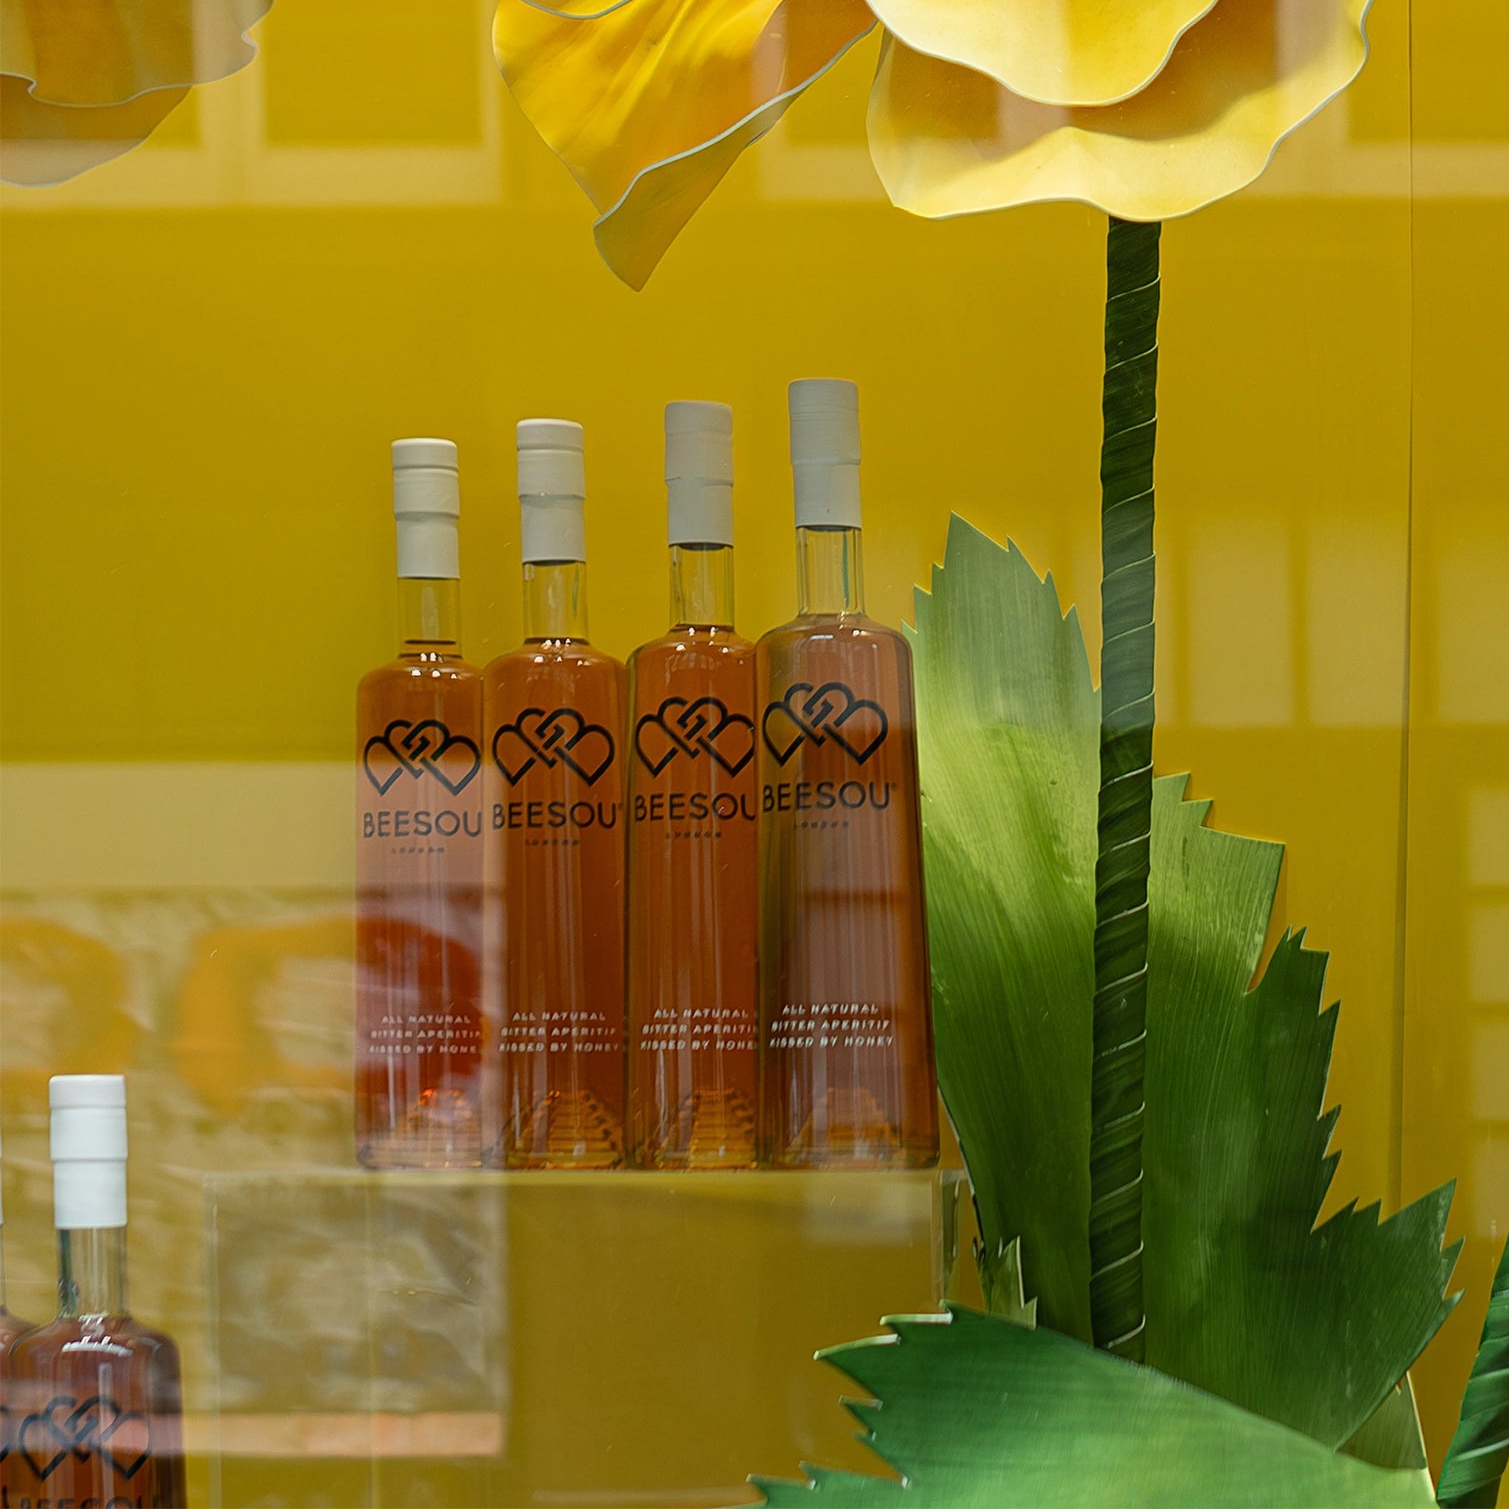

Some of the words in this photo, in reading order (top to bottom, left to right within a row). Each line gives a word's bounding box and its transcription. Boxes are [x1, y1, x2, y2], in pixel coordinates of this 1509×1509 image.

[363, 809, 482, 838] BEESOU
[654, 1008, 678, 1018] ALL
[683, 1008, 749, 1018] NATURAL
[782, 1003, 806, 1015] ALL
[811, 1003, 879, 1014] NATURAL
[381, 1014, 403, 1025] ALL
[407, 1014, 471, 1025] NATURAL
[512, 1011, 537, 1021] ALL
[541, 1011, 606, 1021] NATURAL
[501, 1026, 546, 1037] BITTER
[642, 1023, 688, 1034] BITTER
[693, 1023, 757, 1034] APERITI
[771, 1020, 816, 1032] BITTER
[550, 1042, 568, 1052] BY
[691, 1038, 710, 1050] BY
[716, 1040, 756, 1050] HONE
[820, 1036, 838, 1048] BY
[844, 1036, 893, 1047] HONEY
[416, 1044, 433, 1054] BY
[439, 1044, 477, 1054] HONE
